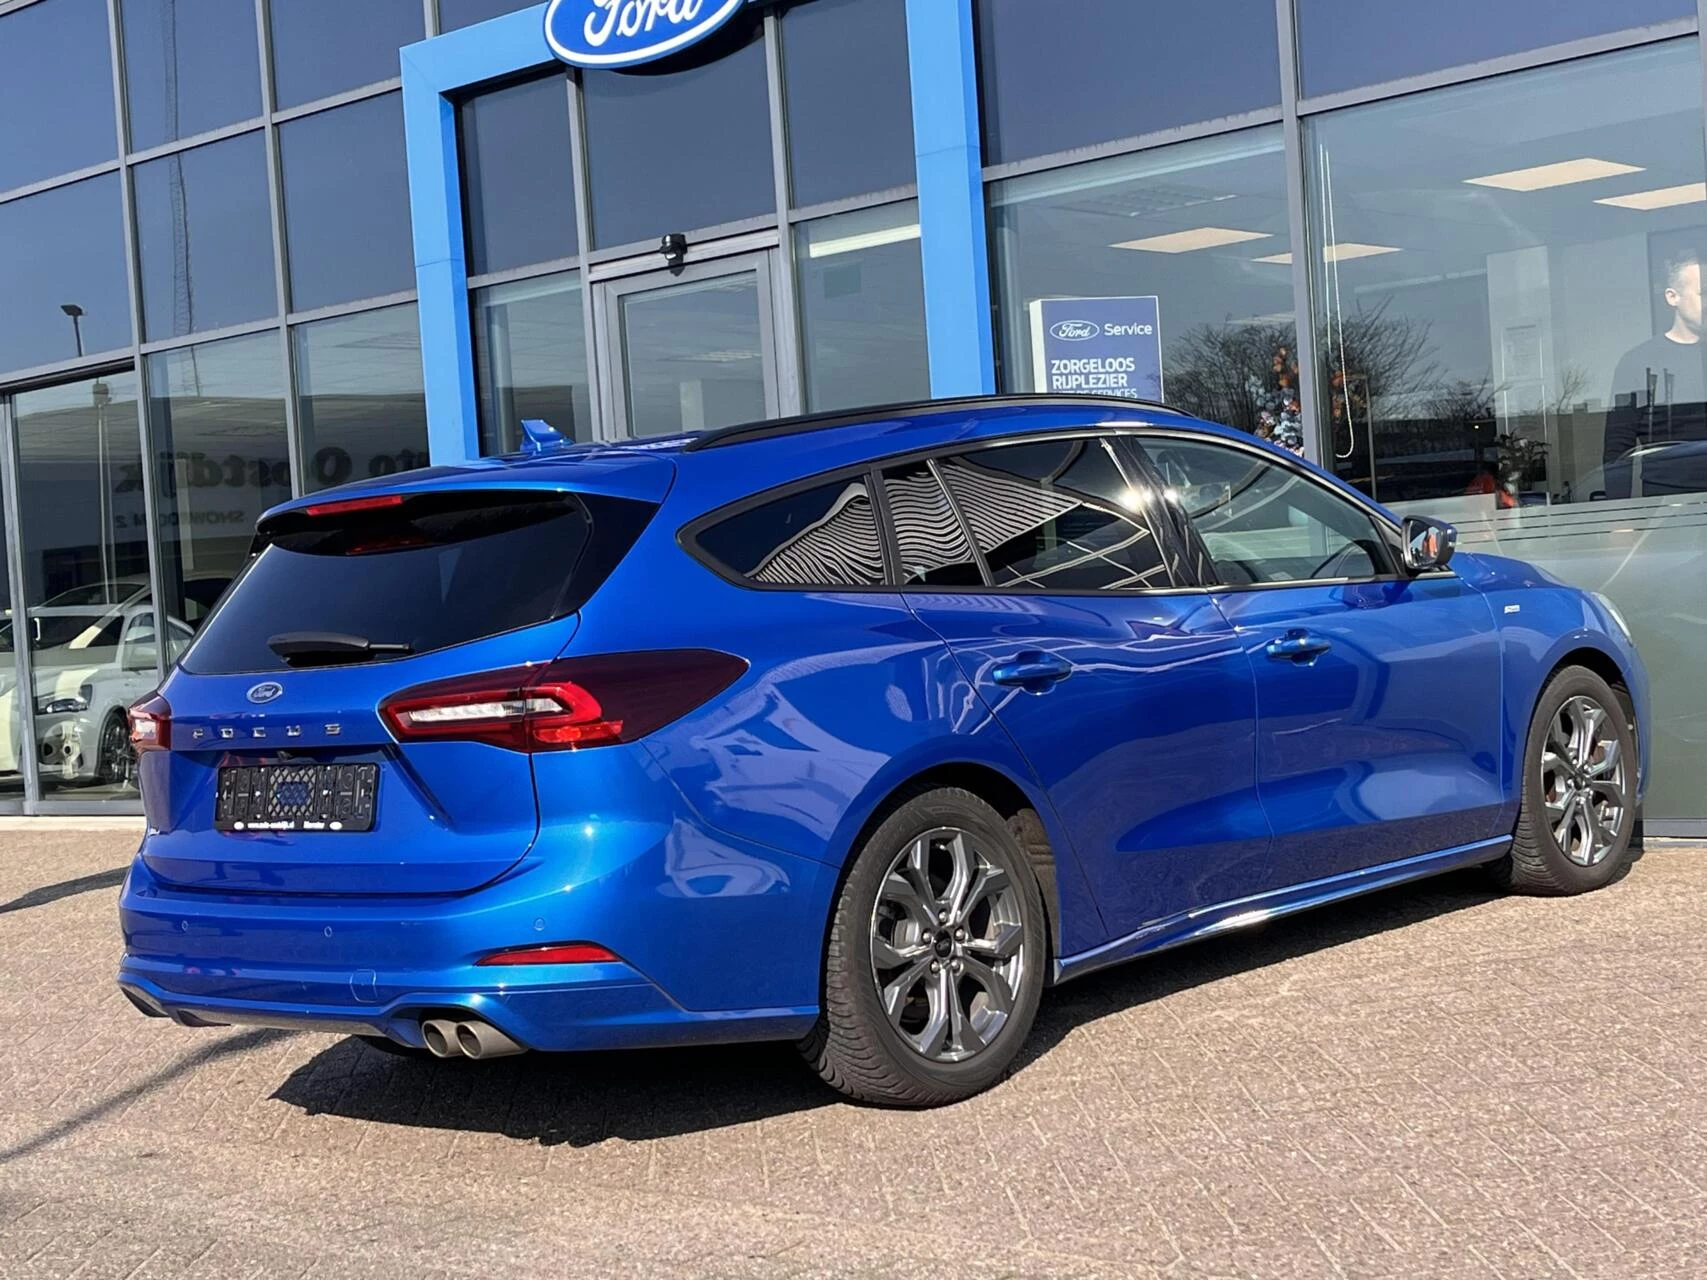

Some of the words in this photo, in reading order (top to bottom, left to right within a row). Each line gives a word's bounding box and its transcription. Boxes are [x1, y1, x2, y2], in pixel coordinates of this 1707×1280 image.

[1059, 322, 1092, 337] Ford
[1104, 322, 1153, 336] Service
[1050, 357, 1136, 374] ZORGELOOS
[1052, 373, 1128, 390] RIJPLEZIER
[191, 723, 342, 739] FOCUS
